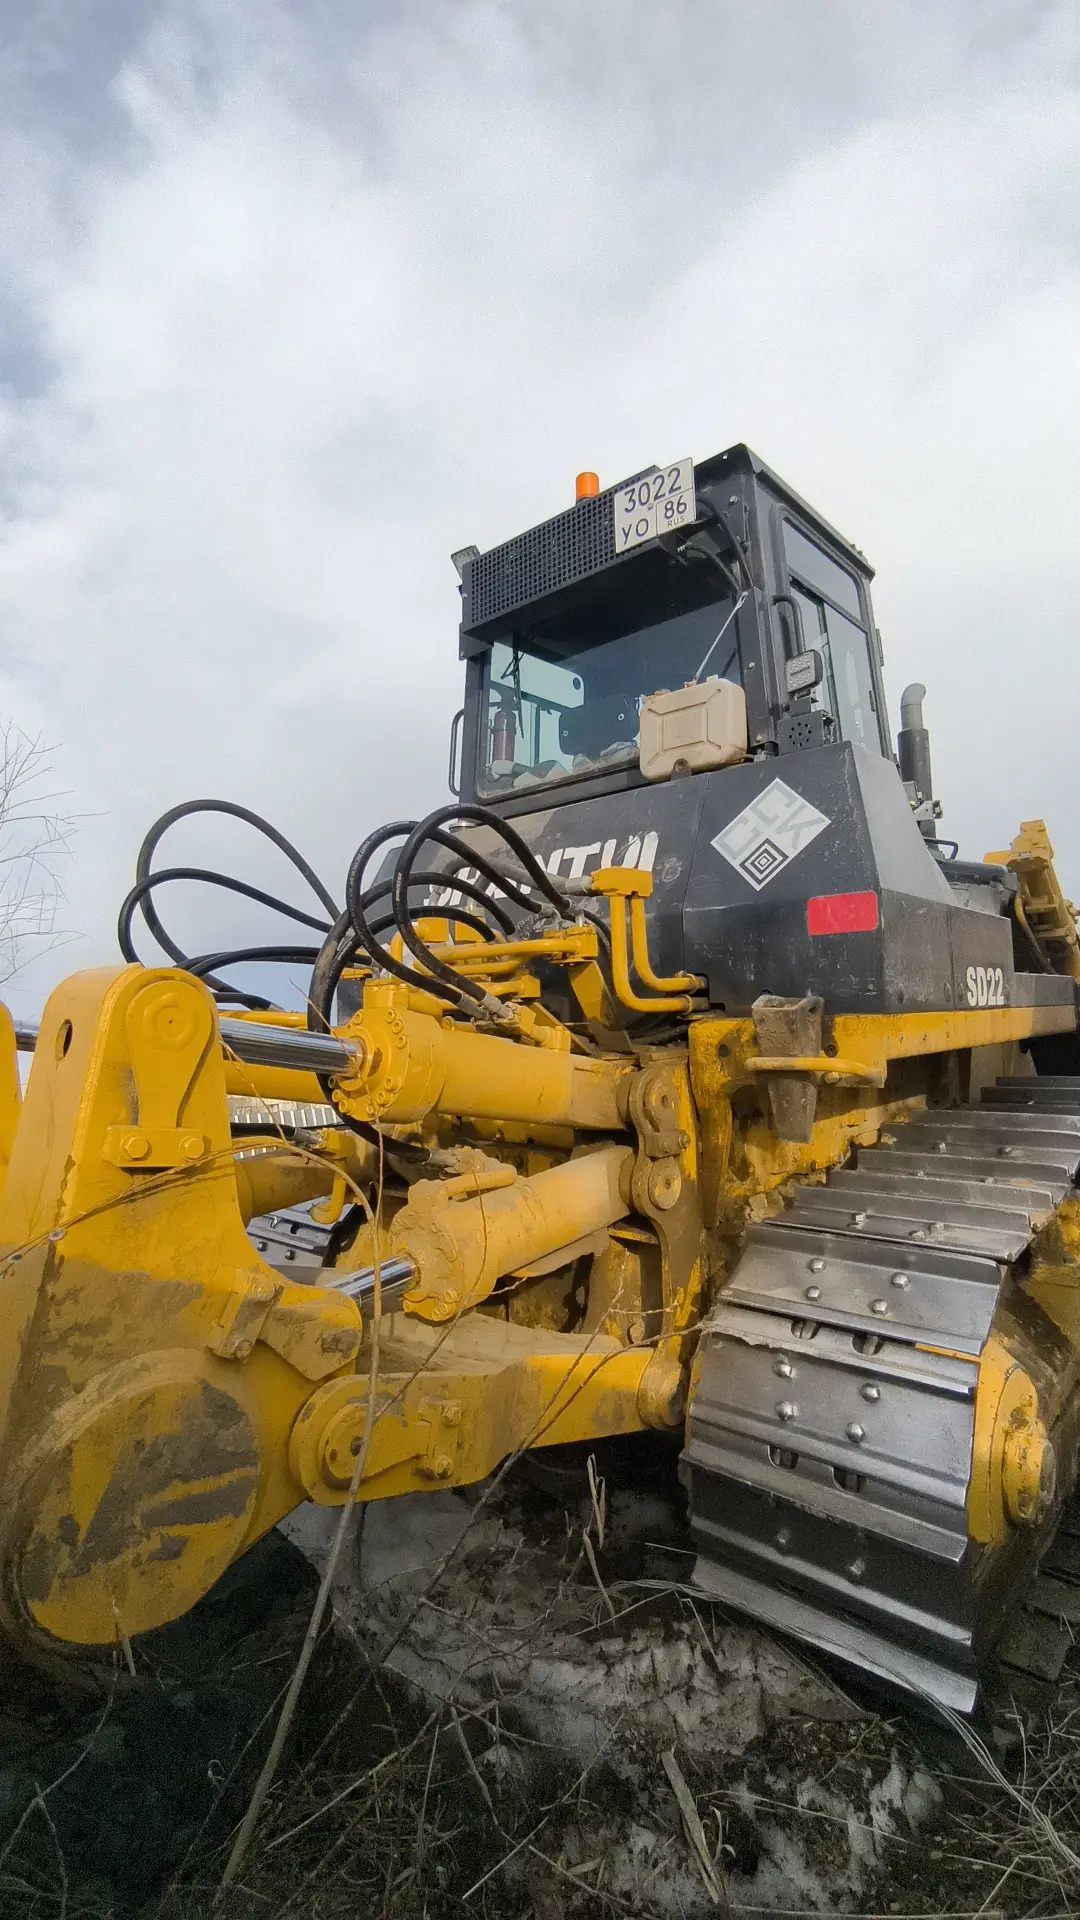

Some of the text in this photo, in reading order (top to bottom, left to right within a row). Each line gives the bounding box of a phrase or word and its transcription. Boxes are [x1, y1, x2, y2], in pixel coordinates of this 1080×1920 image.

[624, 467, 682, 514] 3022
[664, 495, 688, 520] 86
[667, 515, 685, 529] RUS
[966, 966, 1005, 1007] SD22
